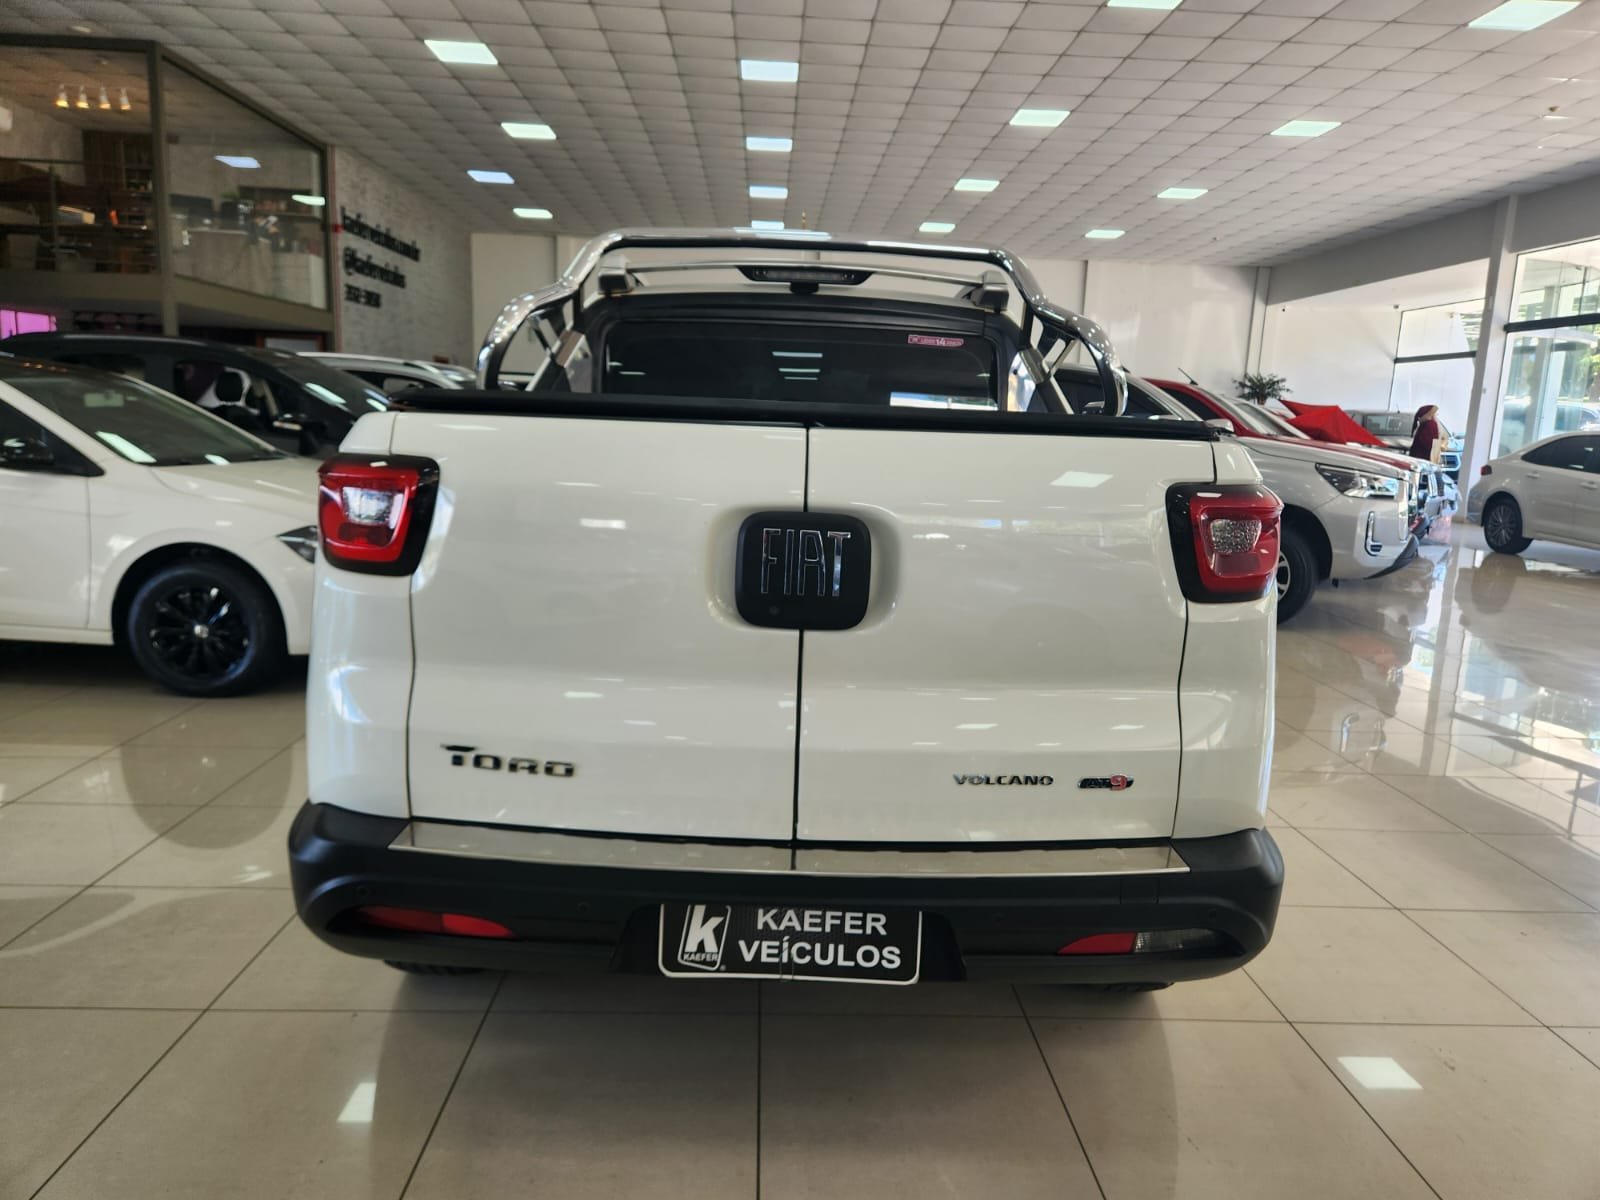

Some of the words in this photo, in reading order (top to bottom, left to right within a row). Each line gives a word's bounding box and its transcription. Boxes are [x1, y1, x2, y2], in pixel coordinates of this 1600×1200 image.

[761, 527, 852, 597] FIAT
[440, 744, 575, 778] TORO
[953, 774, 1054, 786] VOLCANO
[757, 908, 888, 936] KAEFER
[683, 951, 719, 963] KAEFER
[738, 936, 902, 969] VEÍCULOS
